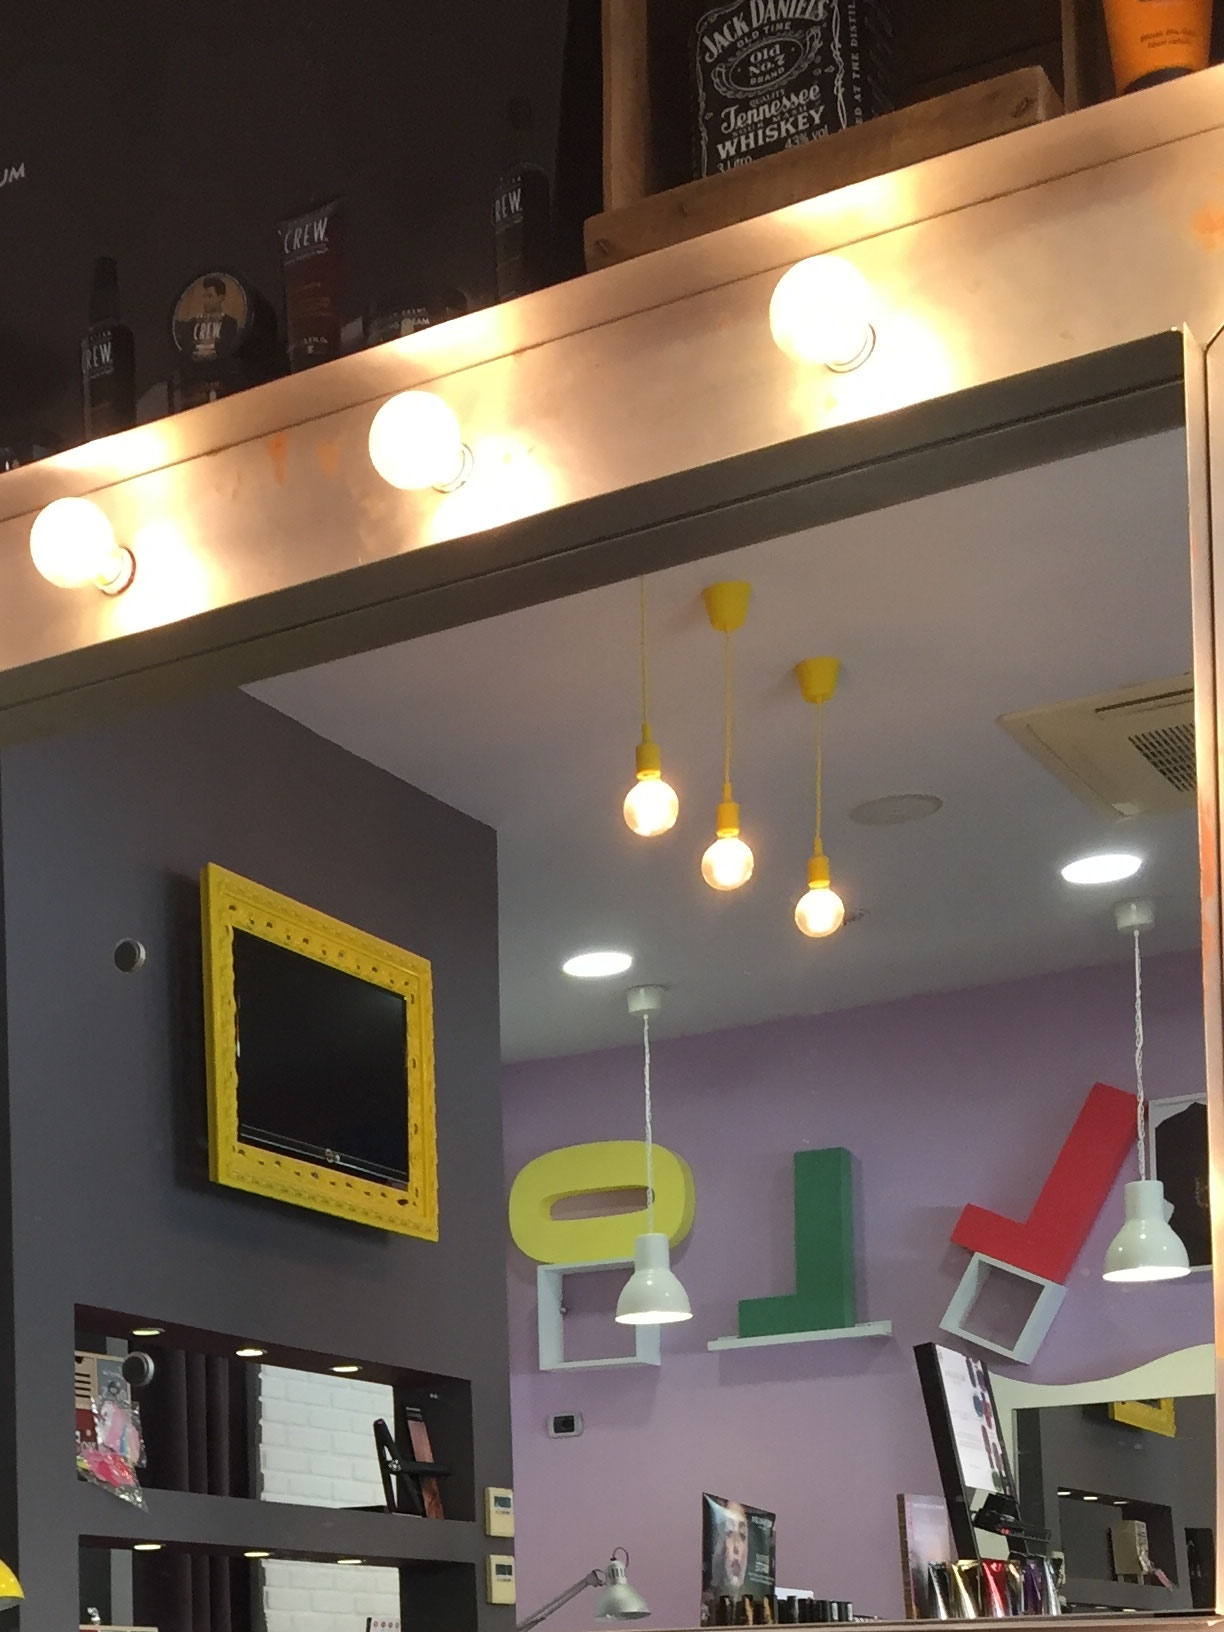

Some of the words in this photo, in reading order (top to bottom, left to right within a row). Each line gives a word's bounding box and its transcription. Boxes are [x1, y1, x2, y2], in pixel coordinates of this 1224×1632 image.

[702, 12, 750, 62] JACK
[736, 31, 760, 49] OLD
[763, 21, 792, 34] TIME
[750, 44, 781, 64] Old
[750, 67, 786, 86] BRAND
[720, 85, 822, 134] Tennessee
[716, 105, 826, 160] WHISKEY
[493, 187, 523, 223] REW
[284, 217, 329, 255] CREW
[193, 321, 223, 342] CREW
[84, 341, 114, 370] REW
